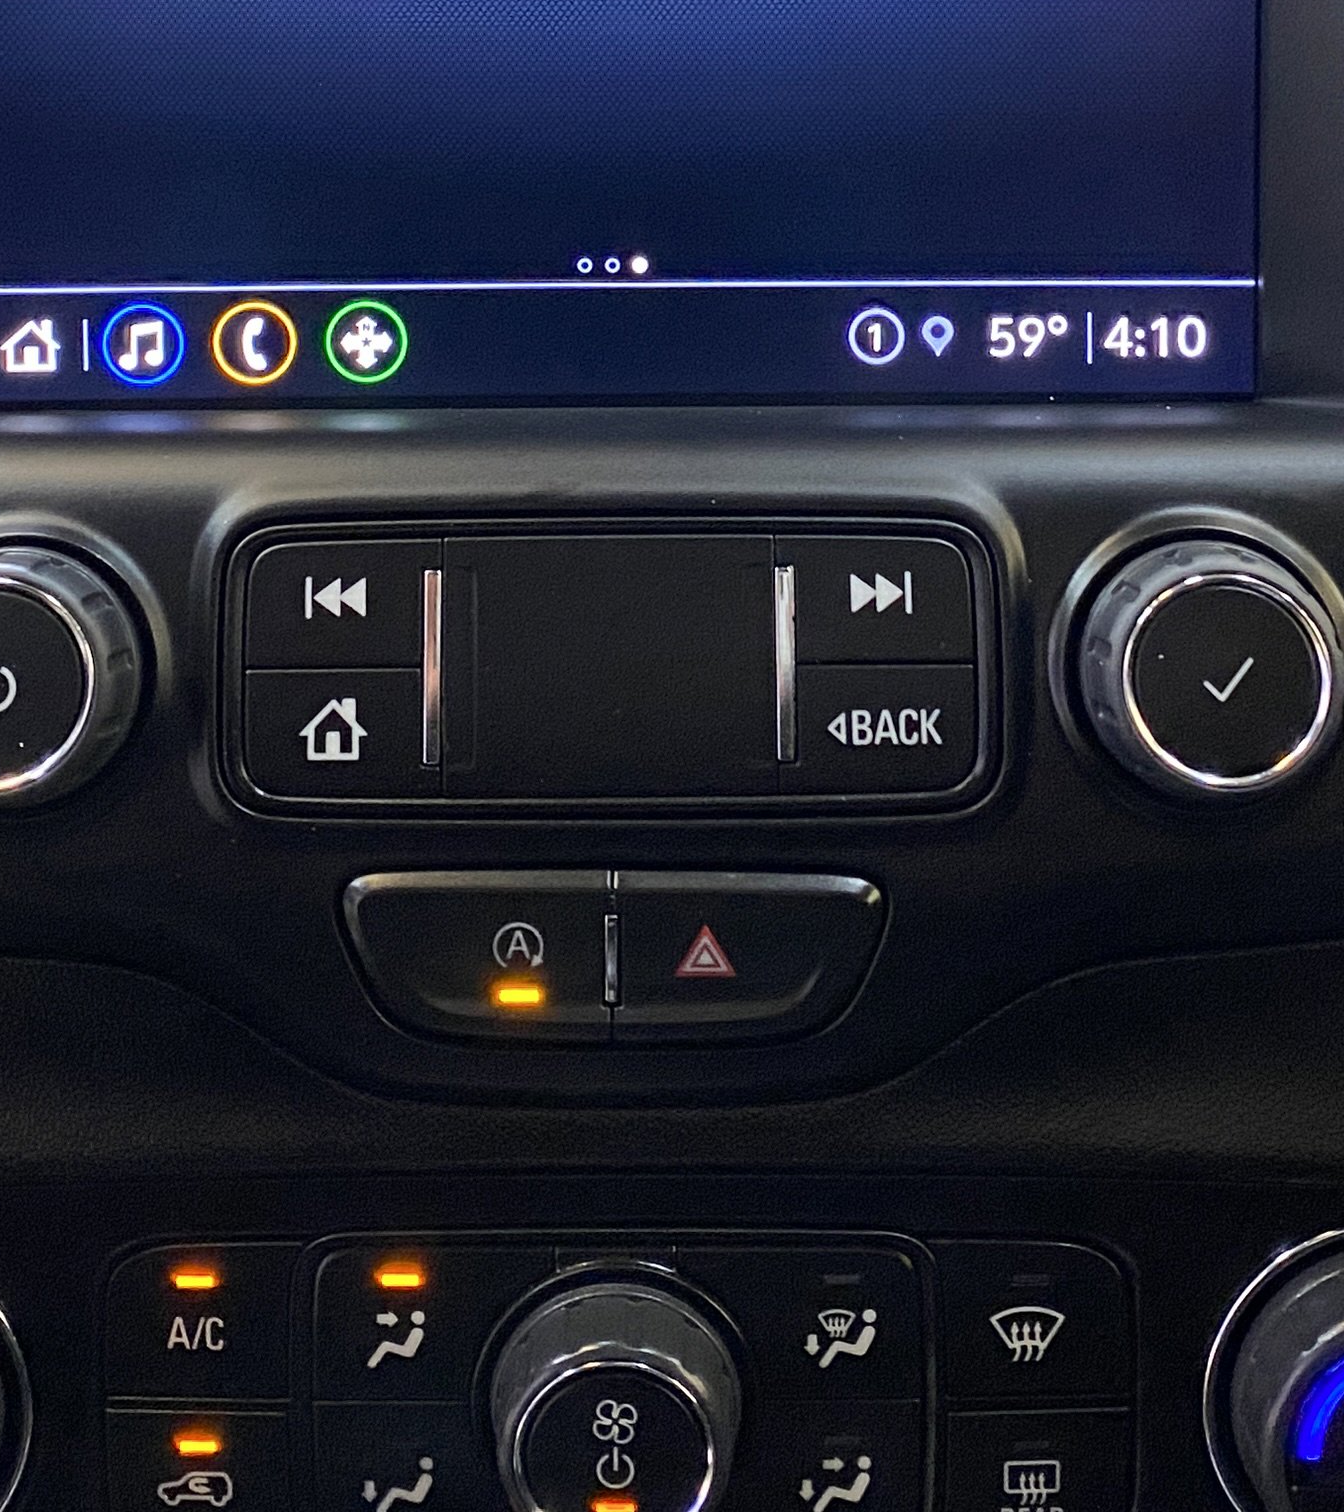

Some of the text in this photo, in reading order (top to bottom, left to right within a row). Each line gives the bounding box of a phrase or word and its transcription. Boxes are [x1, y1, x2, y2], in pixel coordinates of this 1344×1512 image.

[866, 321, 883, 354] 1
[987, 314, 1069, 359] 59°
[1102, 315, 1208, 359] 4:10
[850, 708, 944, 746] BACK
[166, 1315, 225, 1352] A/C
